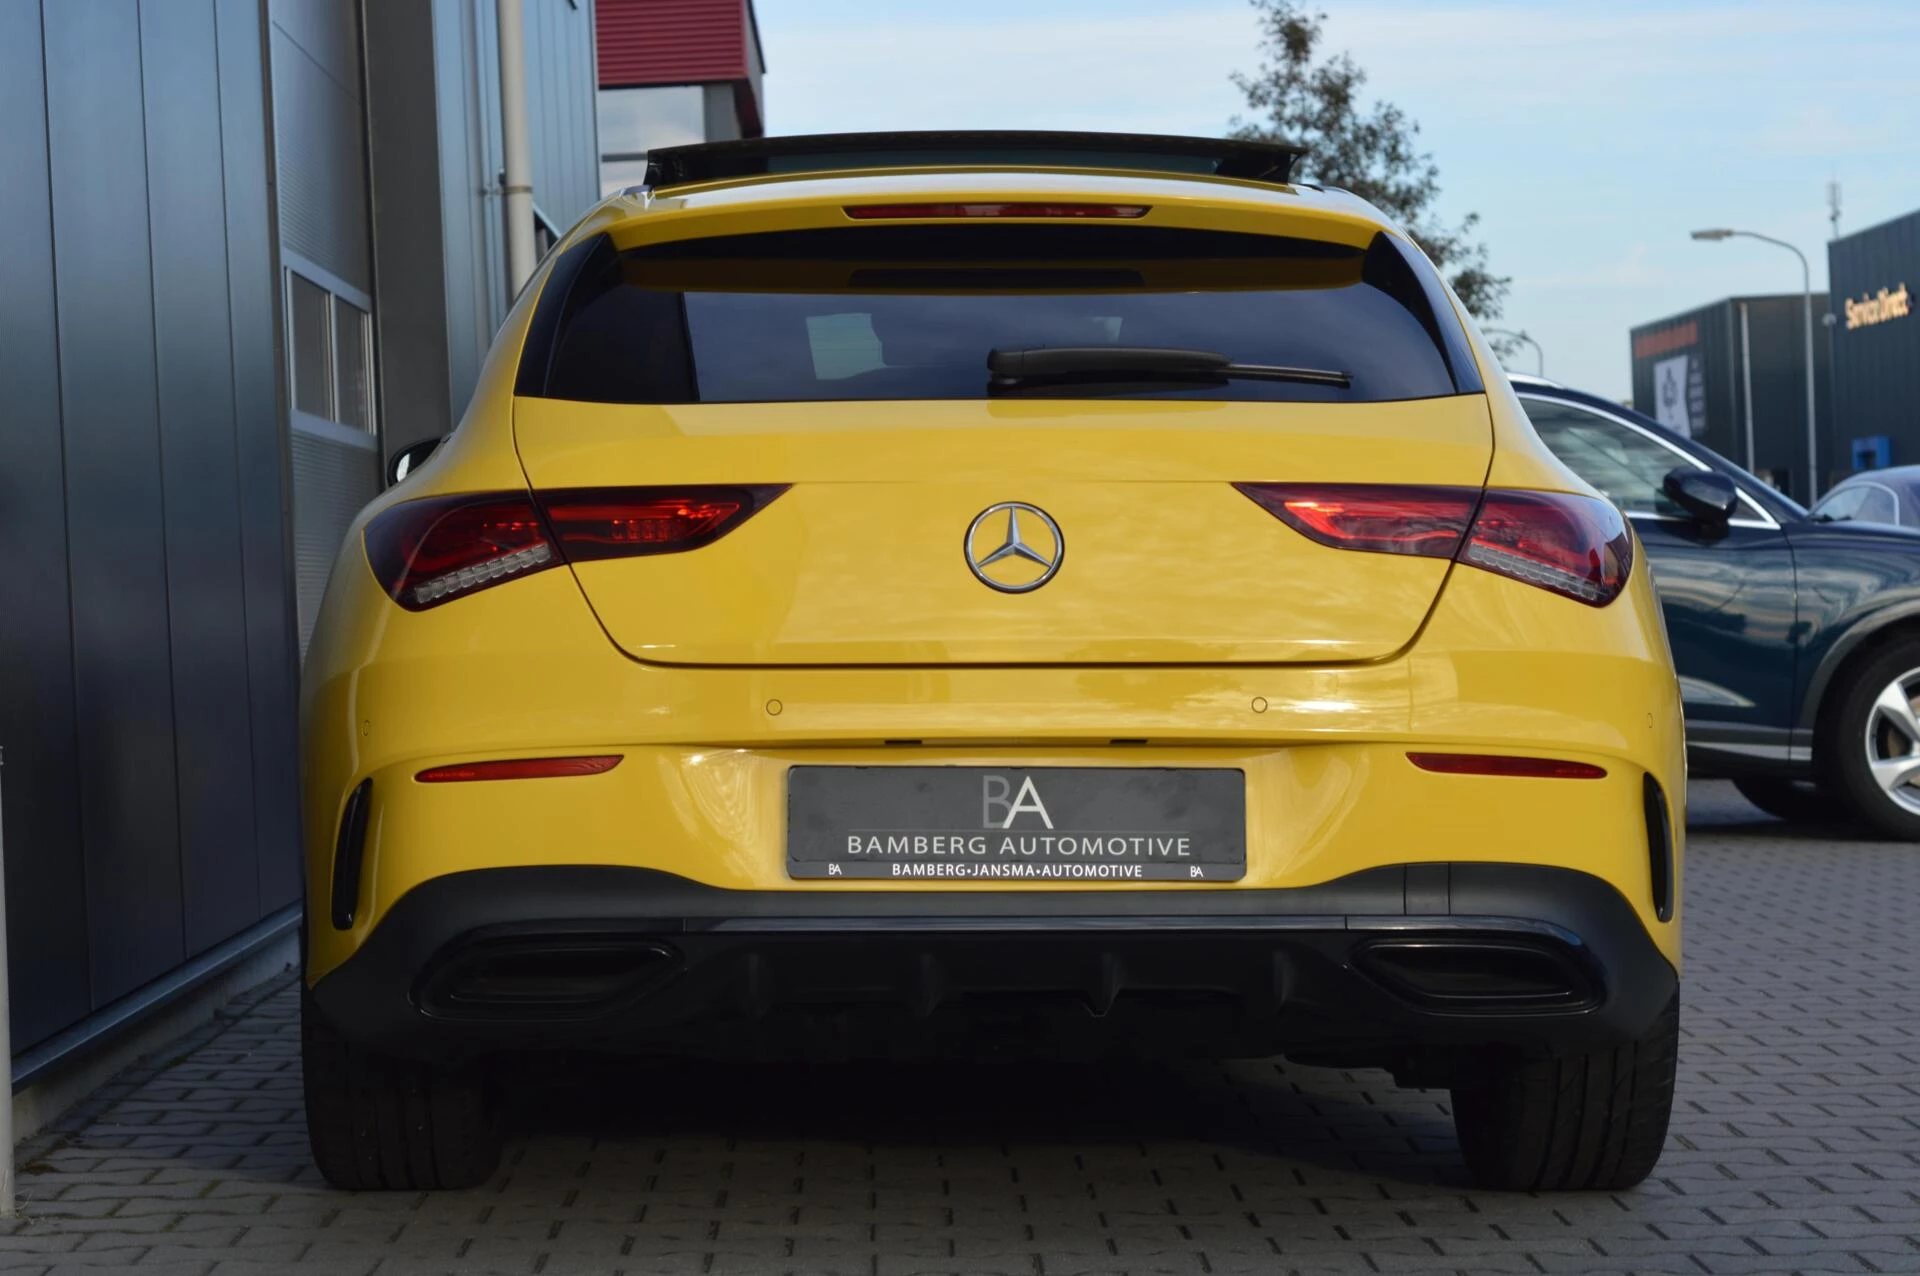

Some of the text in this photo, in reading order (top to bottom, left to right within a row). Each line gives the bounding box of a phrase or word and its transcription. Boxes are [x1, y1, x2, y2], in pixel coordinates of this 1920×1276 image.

[983, 775, 1054, 829] BA
[847, 835, 1190, 856] BAMBERG AUTOMOTIVE
[828, 863, 842, 875] BA
[1190, 866, 1203, 878] BA
